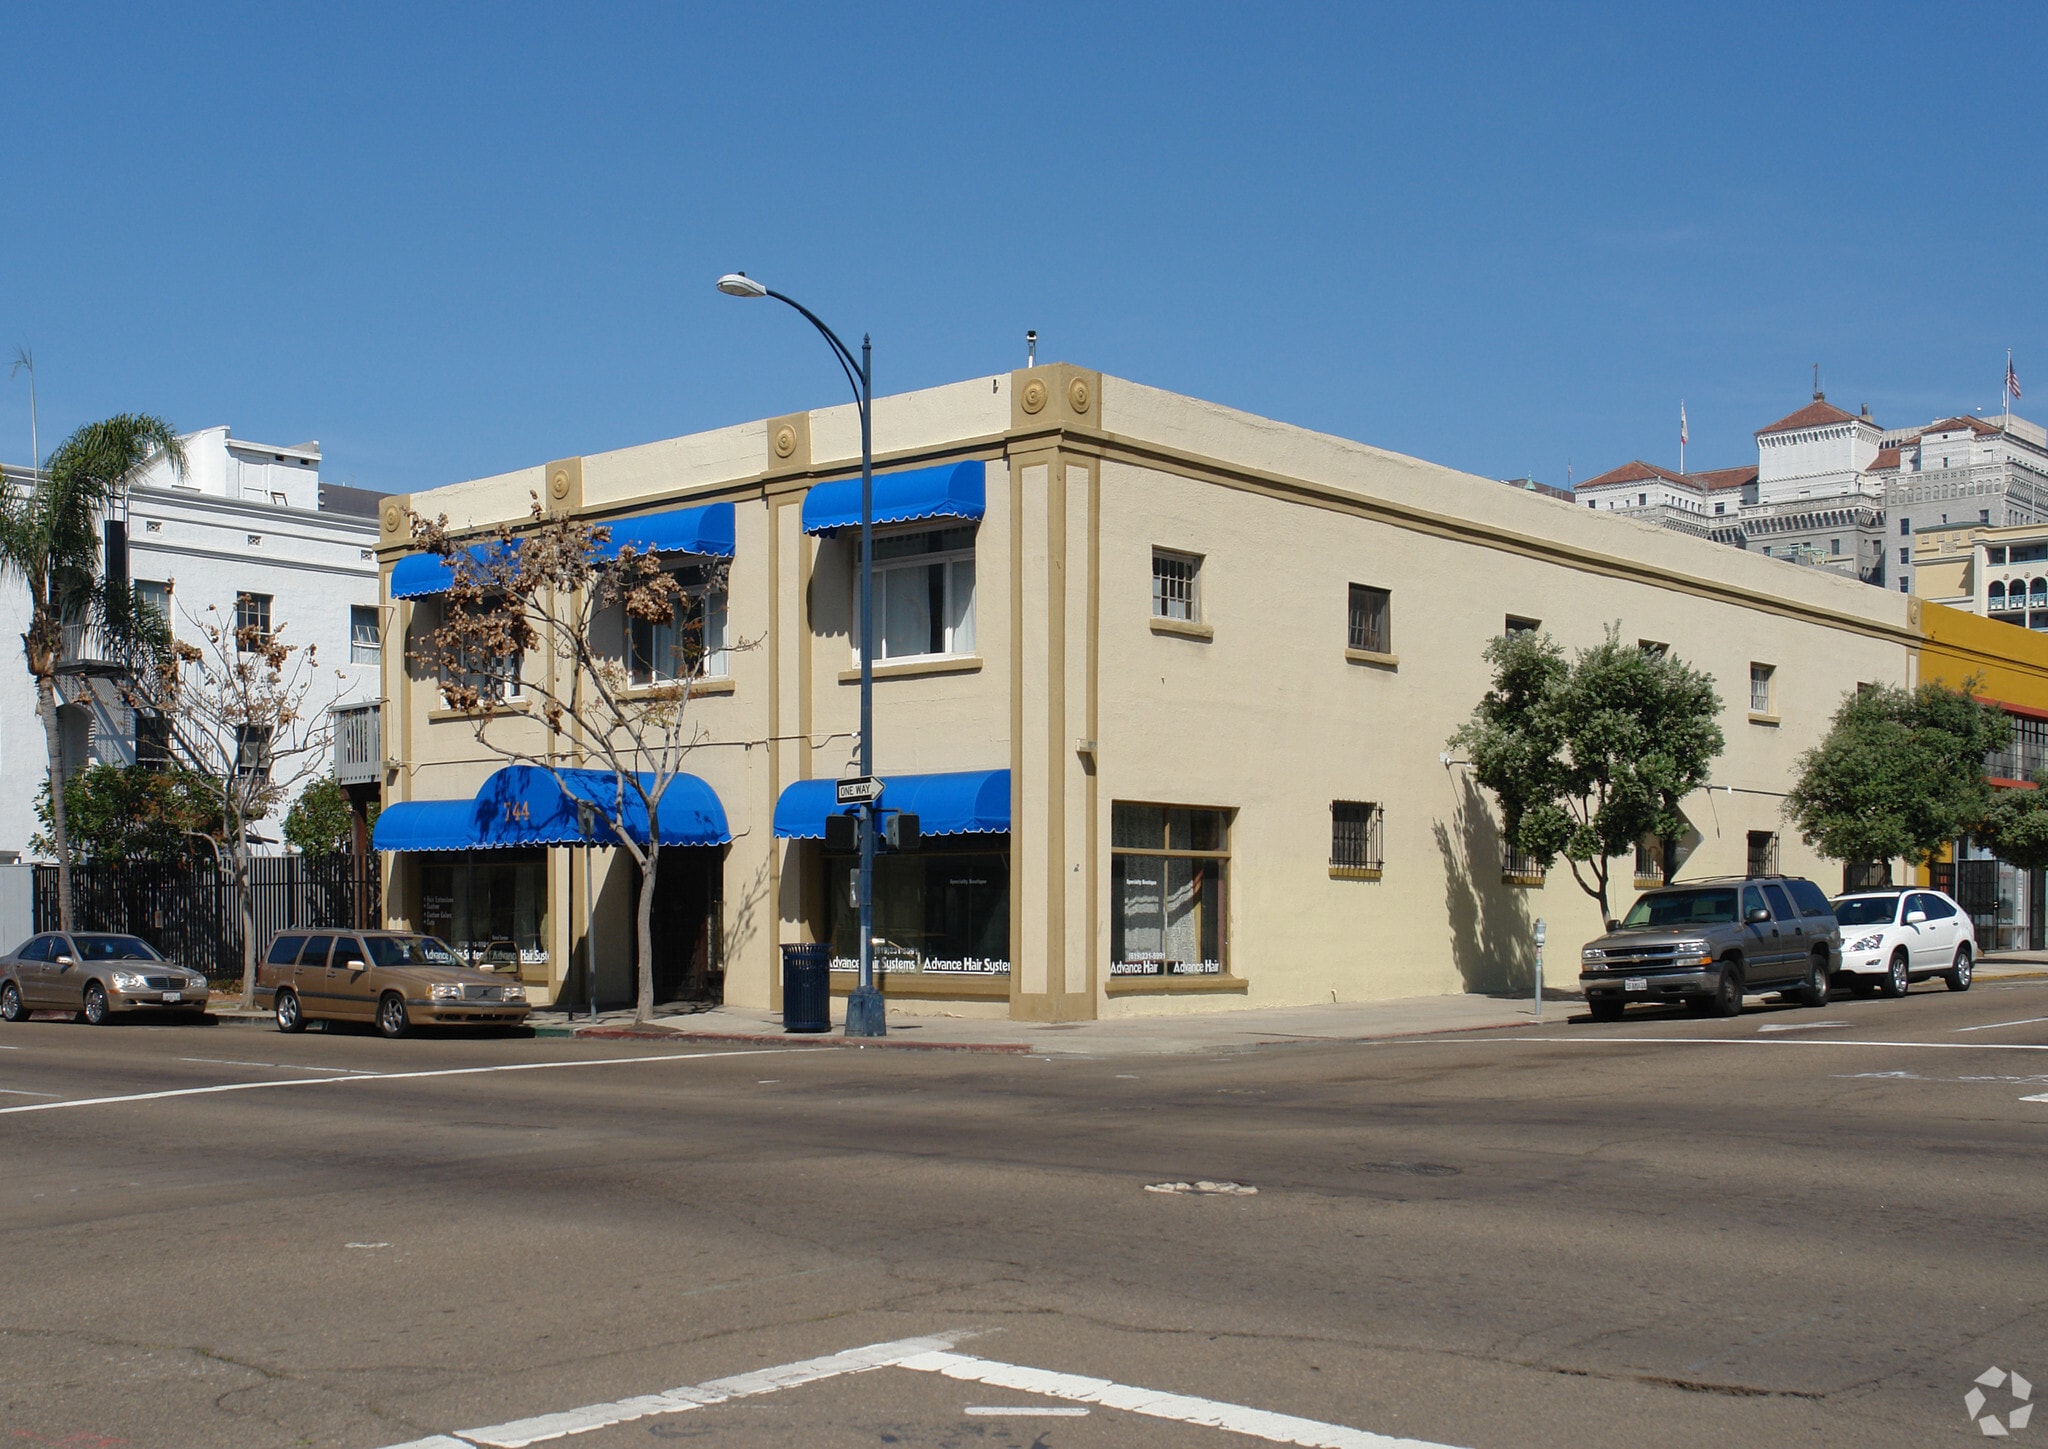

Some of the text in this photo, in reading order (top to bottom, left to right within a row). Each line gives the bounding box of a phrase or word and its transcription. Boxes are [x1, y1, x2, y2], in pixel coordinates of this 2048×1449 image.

[841, 784, 871, 796] ONE WAY
[504, 801, 530, 822] 744
[520, 949, 533, 960] Hair
[880, 956, 915, 972] Systems
[923, 957, 962, 970] Advance
[963, 957, 982, 971] Hair
[1110, 960, 1159, 974] Advance Hair
[1173, 959, 1220, 973] Advance Hair
